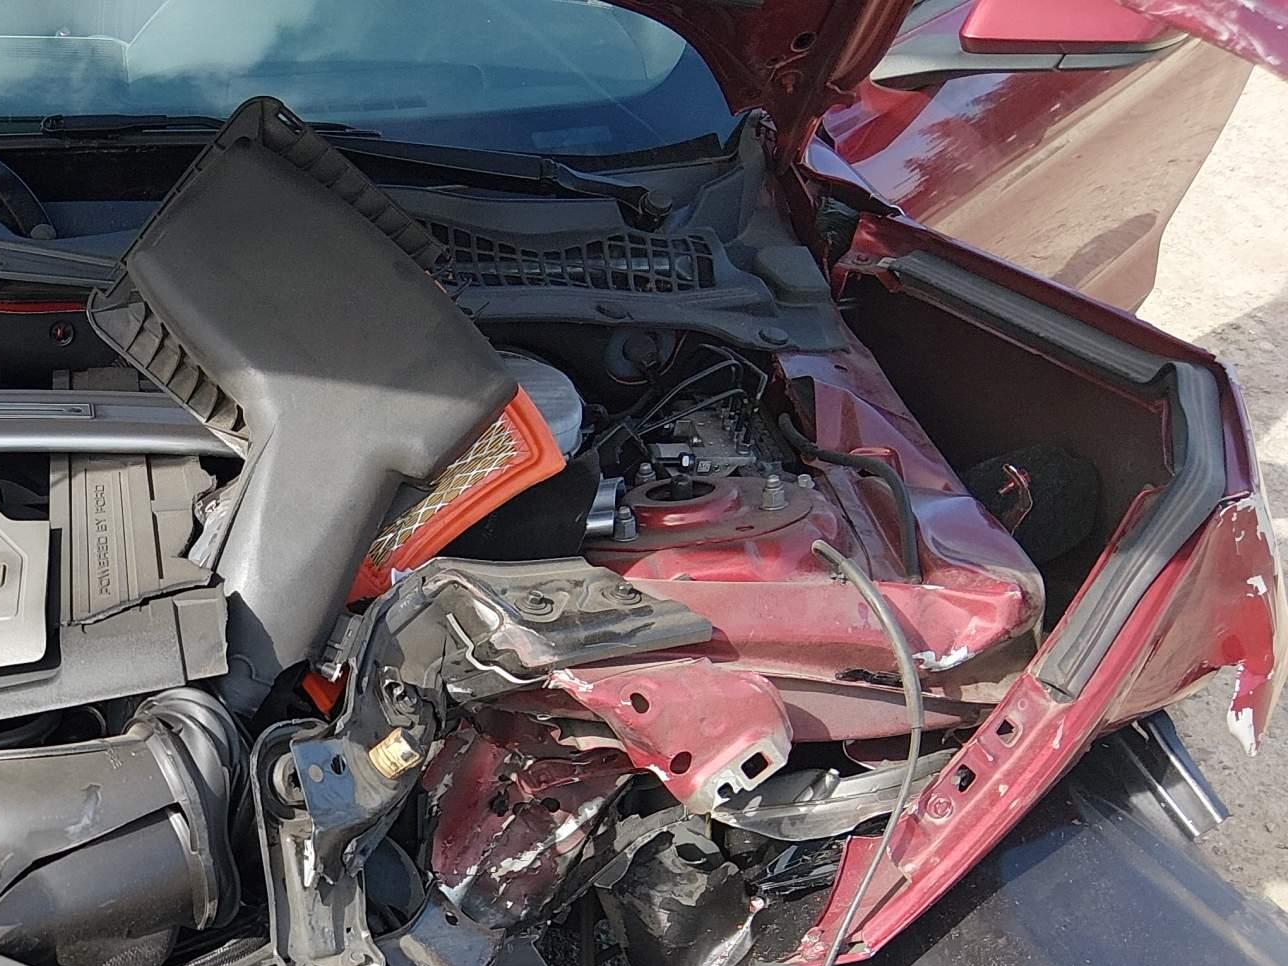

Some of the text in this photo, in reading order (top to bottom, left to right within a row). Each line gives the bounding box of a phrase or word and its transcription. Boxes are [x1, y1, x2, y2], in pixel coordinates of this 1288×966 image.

[94, 484, 111, 595] POWERED BY FORD
